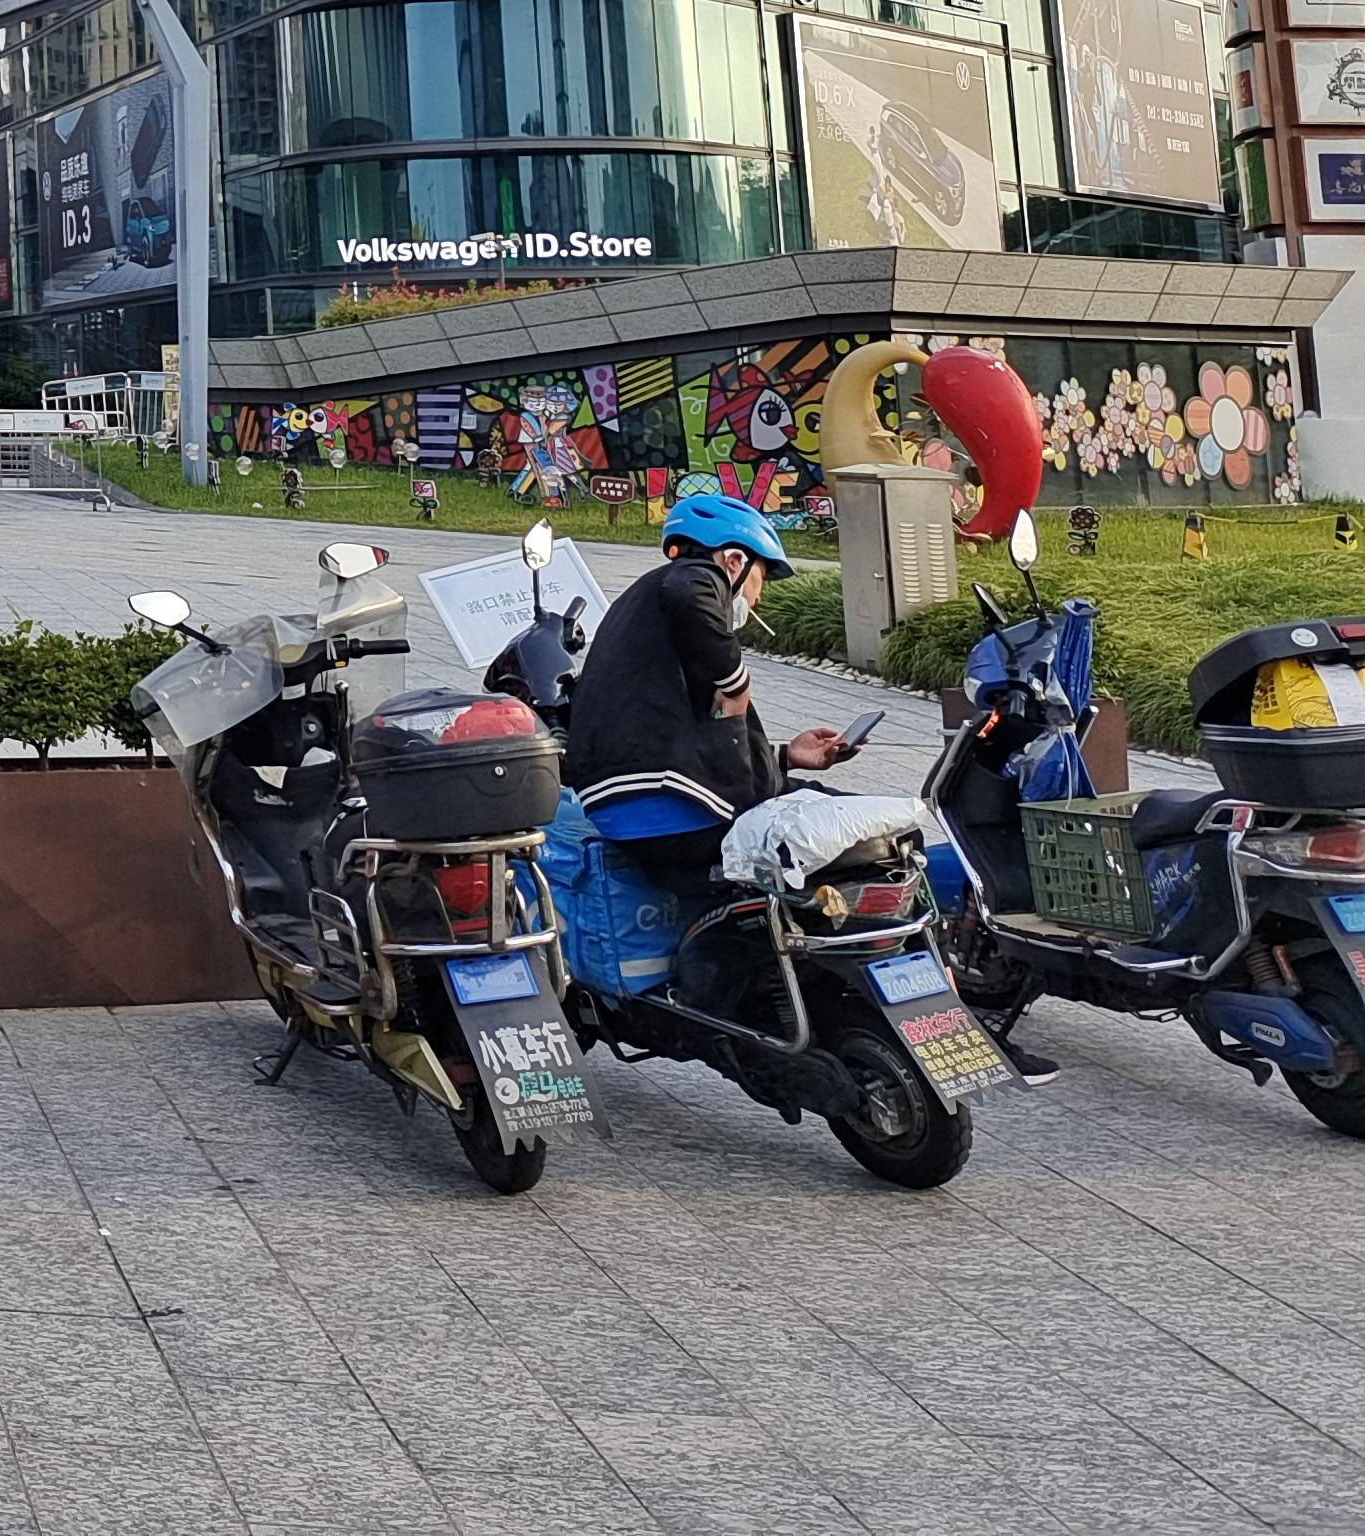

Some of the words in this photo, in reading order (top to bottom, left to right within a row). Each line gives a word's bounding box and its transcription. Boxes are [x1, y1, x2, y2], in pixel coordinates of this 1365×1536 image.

[62, 204, 92, 249] ID.3
[337, 237, 518, 266] Volkswagen
[526, 231, 652, 259] ID.Store
